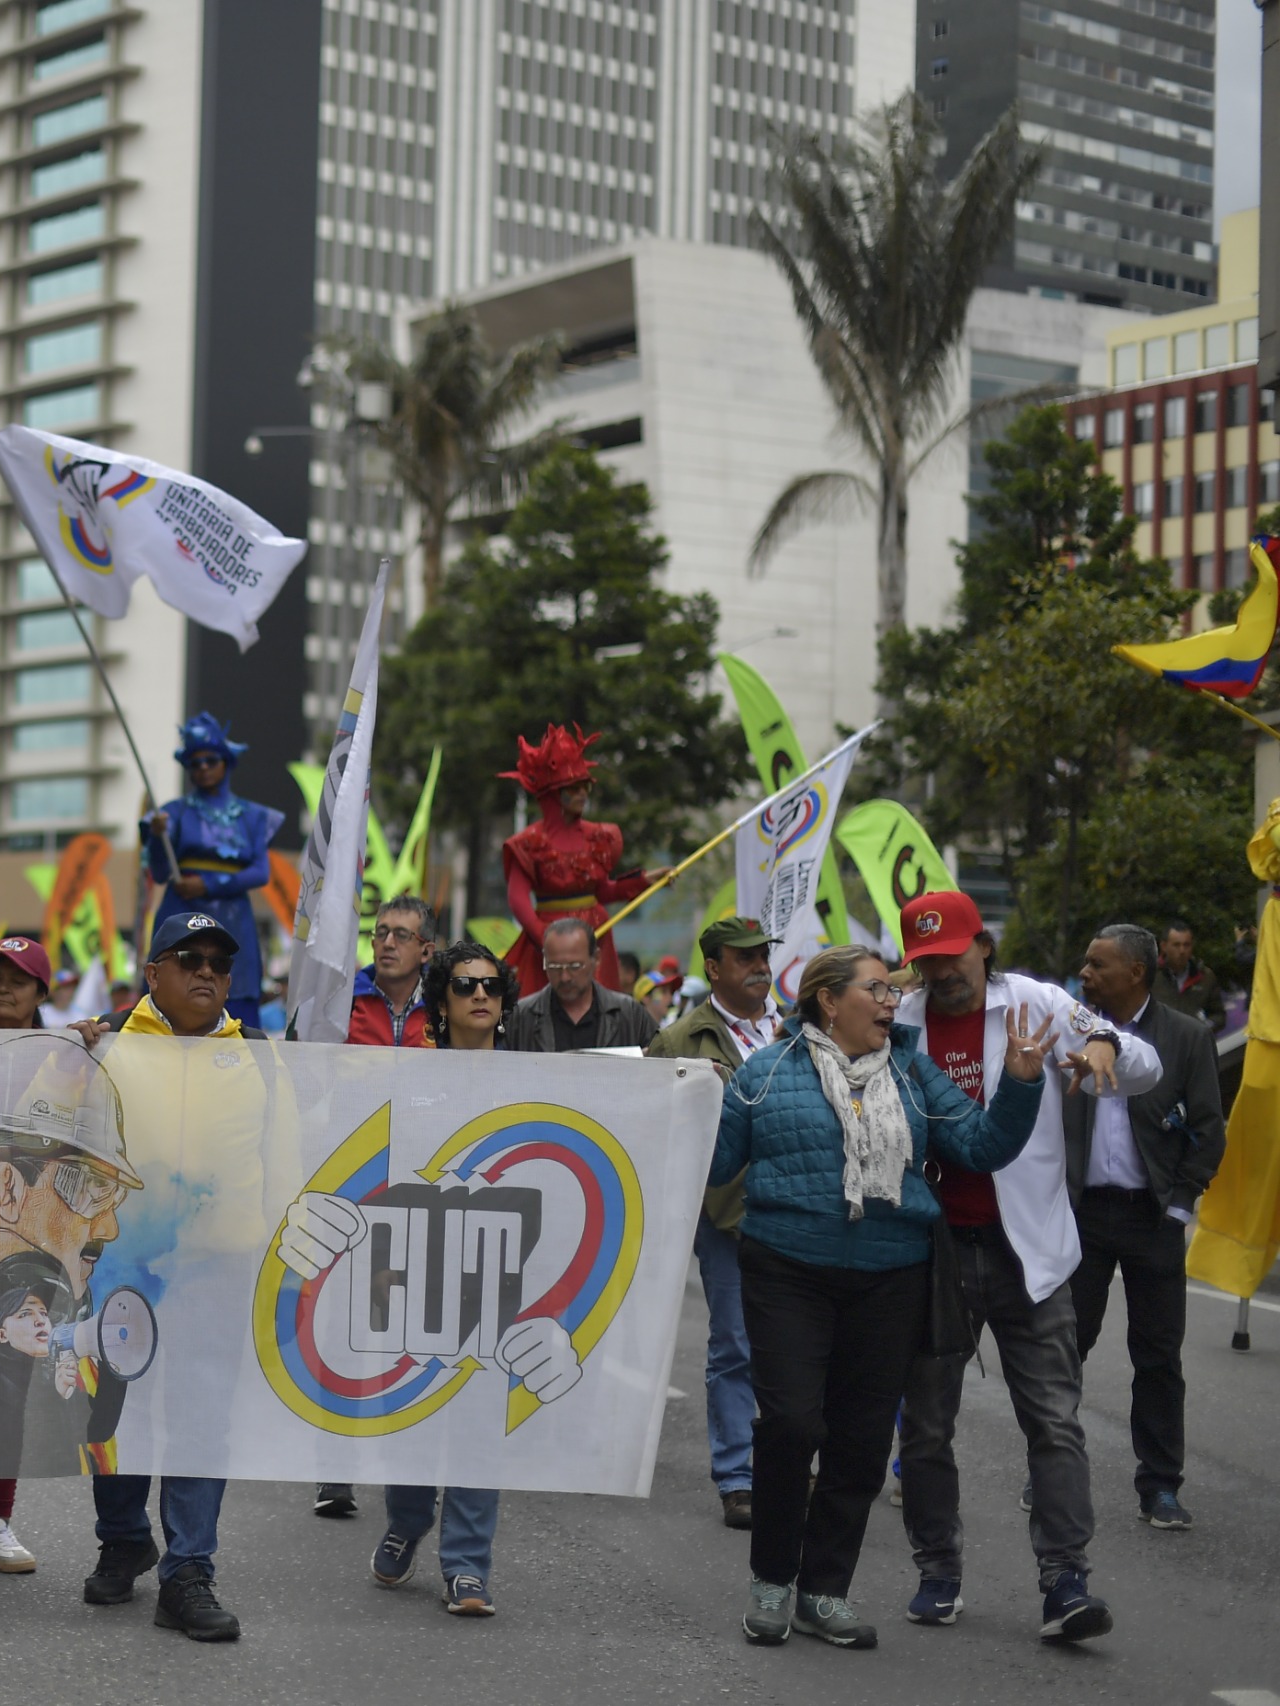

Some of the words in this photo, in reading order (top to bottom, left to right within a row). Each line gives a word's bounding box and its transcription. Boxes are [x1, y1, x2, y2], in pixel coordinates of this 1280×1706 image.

[160, 498, 263, 588] TRABAJADORES
[166, 484, 234, 543] UNITARIA
[231, 535, 255, 561] DE
[945, 1051, 967, 1063] Otra
[349, 1184, 542, 1359] CUT
